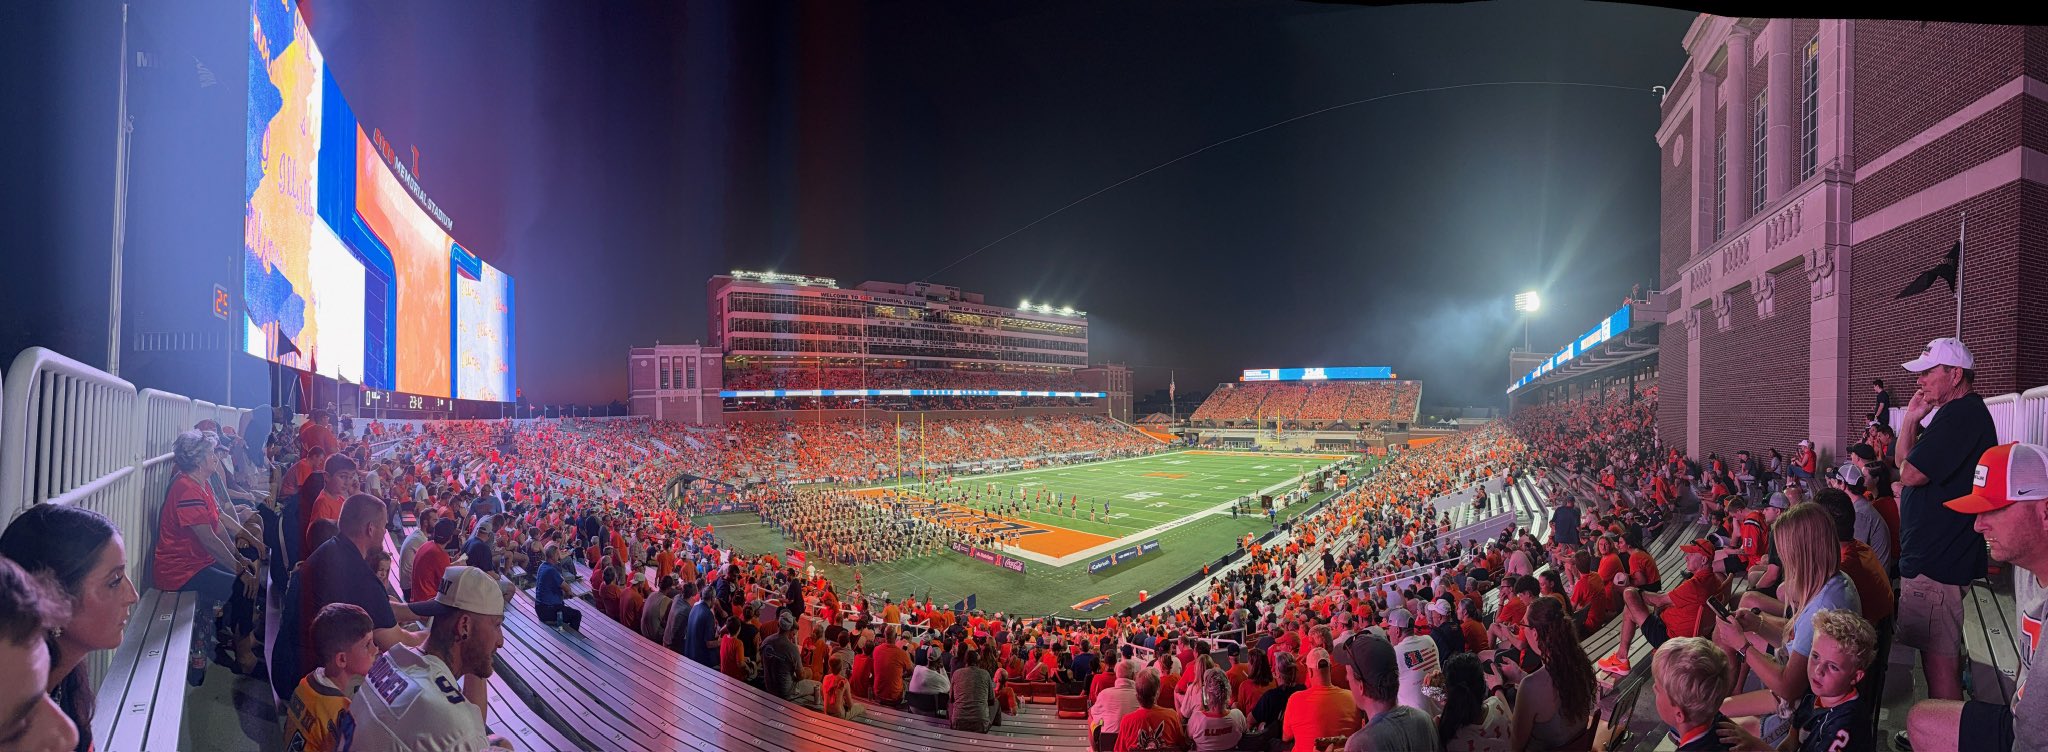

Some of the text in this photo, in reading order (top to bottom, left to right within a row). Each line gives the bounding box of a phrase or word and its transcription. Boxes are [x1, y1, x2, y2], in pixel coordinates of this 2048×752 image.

[394, 155, 428, 208] MEMORIAL
[427, 198, 454, 231] STADIUM
[874, 297, 902, 305] MEMORIAL
[937, 324, 964, 332] CHAMPIONS
[367, 654, 409, 706] OUCHER
[1828, 729, 1850, 752] 2
